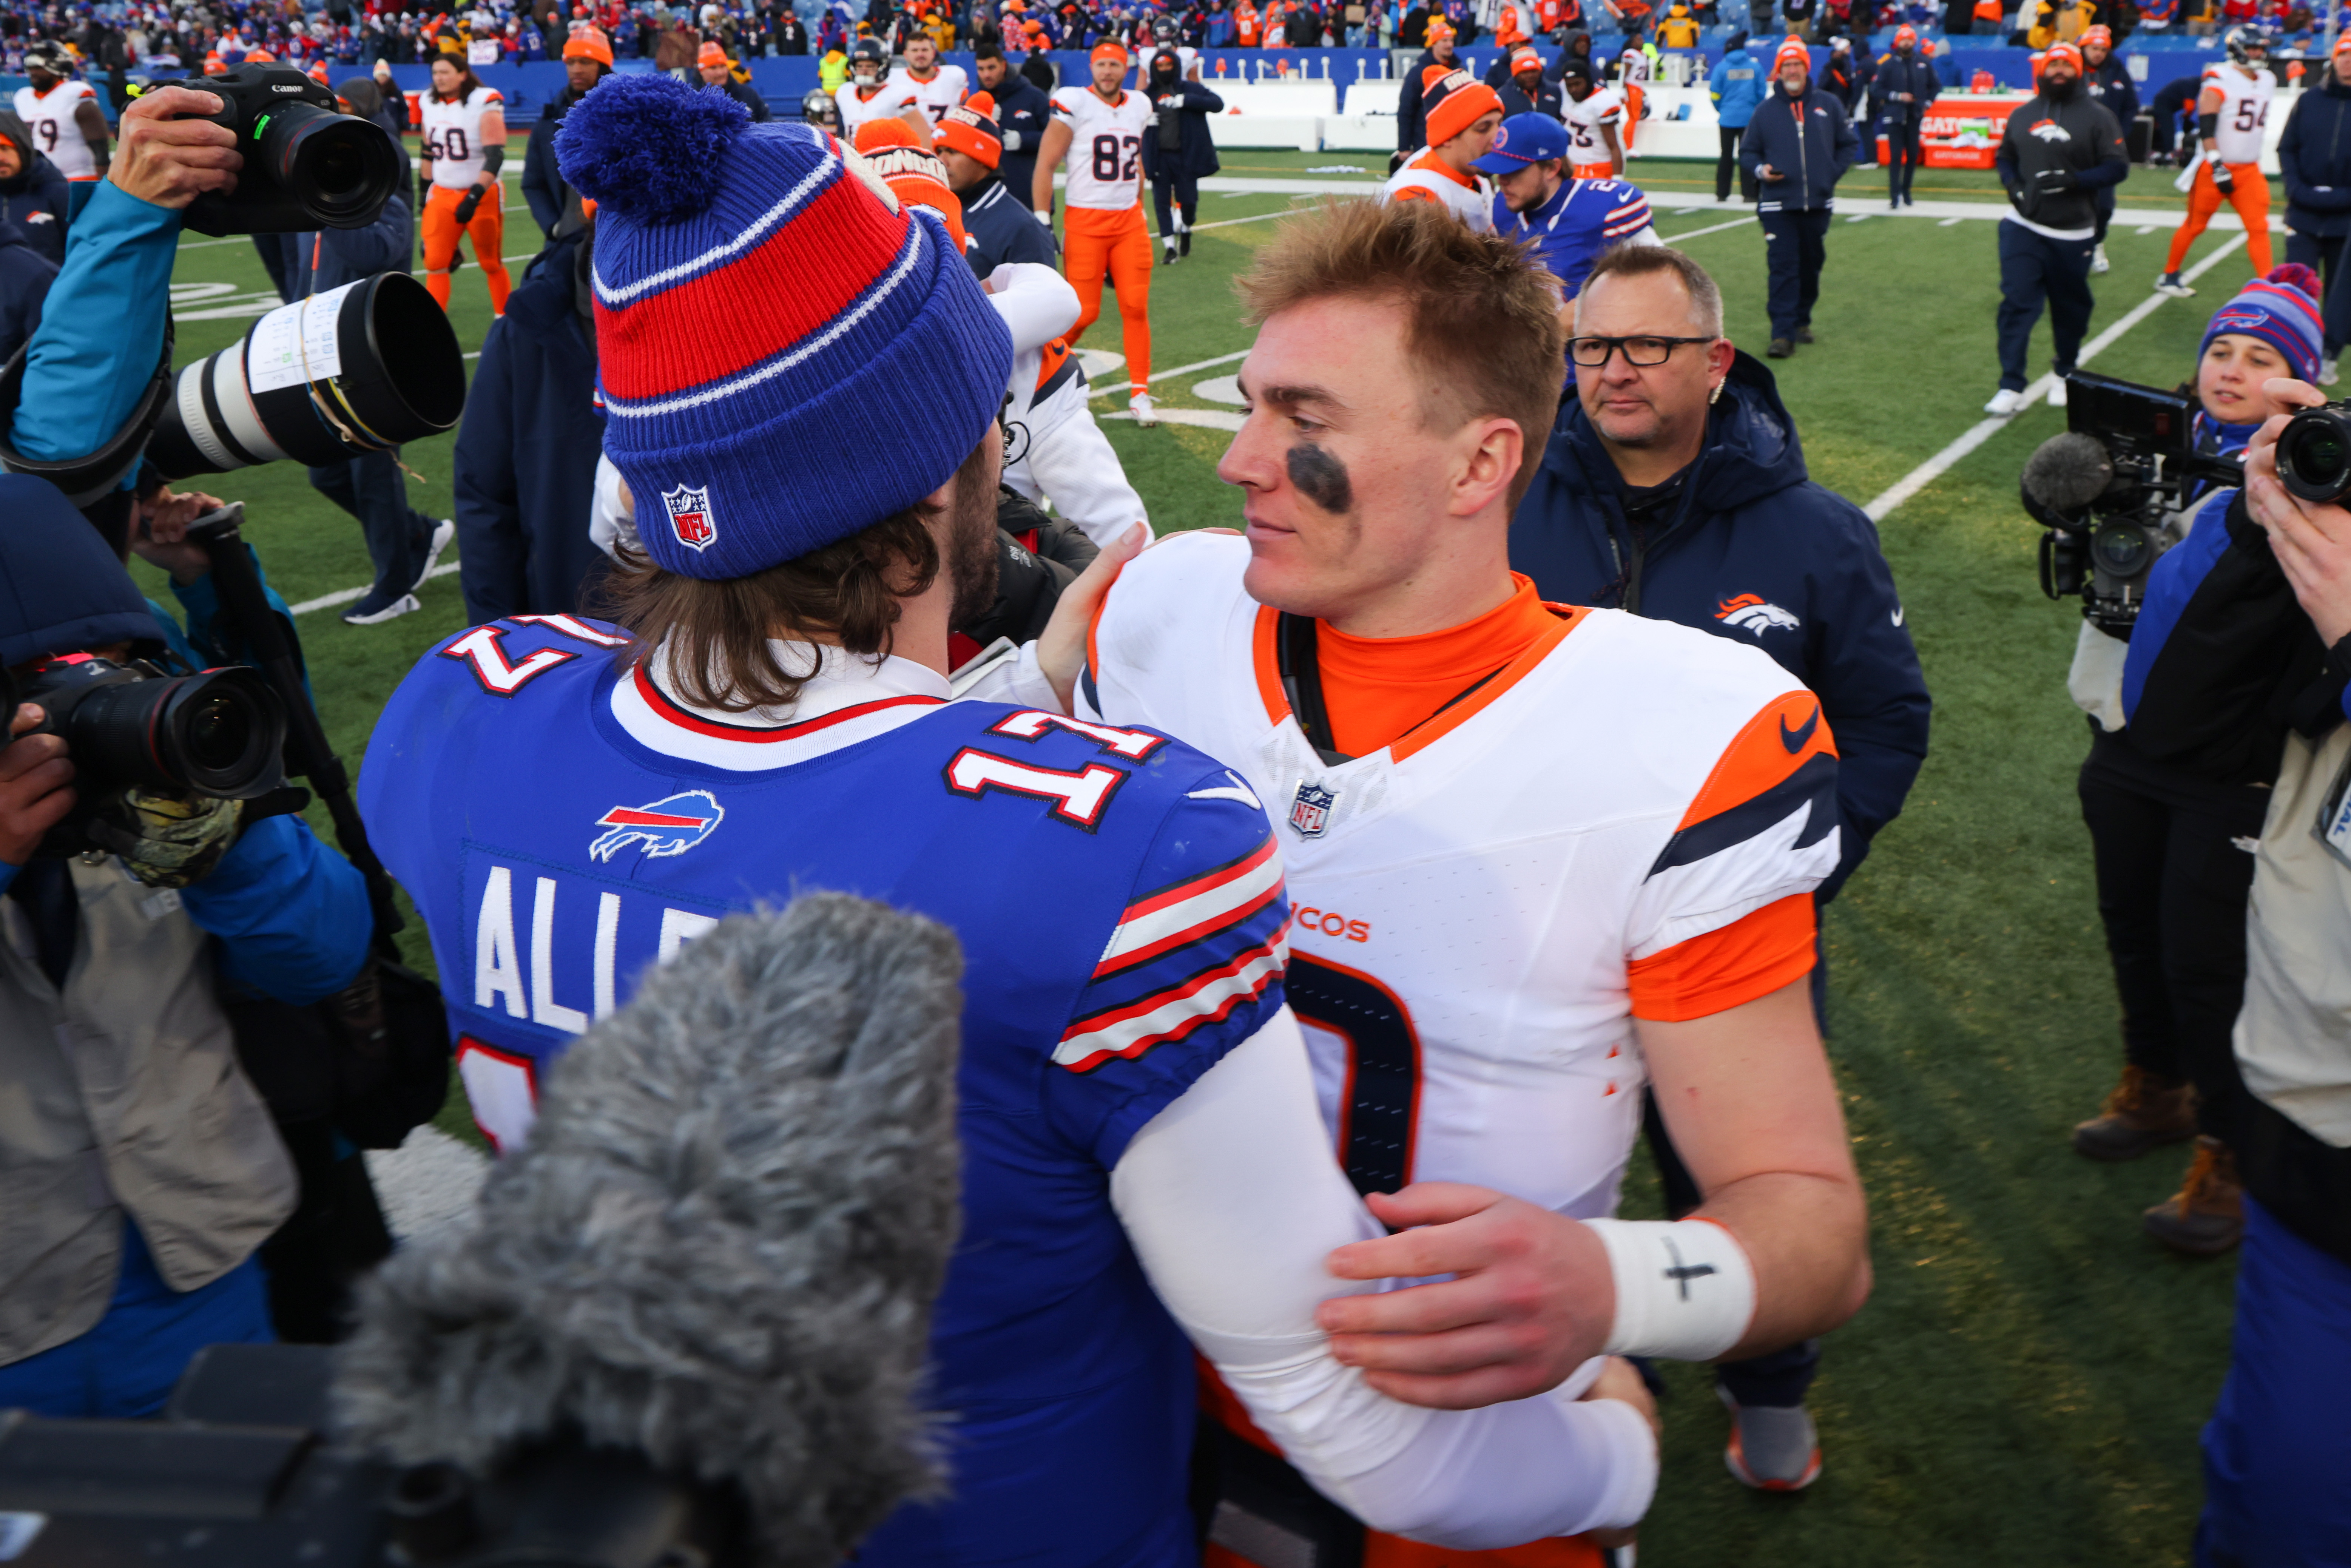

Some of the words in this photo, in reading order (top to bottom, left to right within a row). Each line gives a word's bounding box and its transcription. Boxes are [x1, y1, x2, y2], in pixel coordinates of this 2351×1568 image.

[272, 84, 303, 93] Canon
[1093, 135, 1140, 181] 82
[674, 513, 711, 542] NFL
[1293, 803, 1323, 829] NFL
